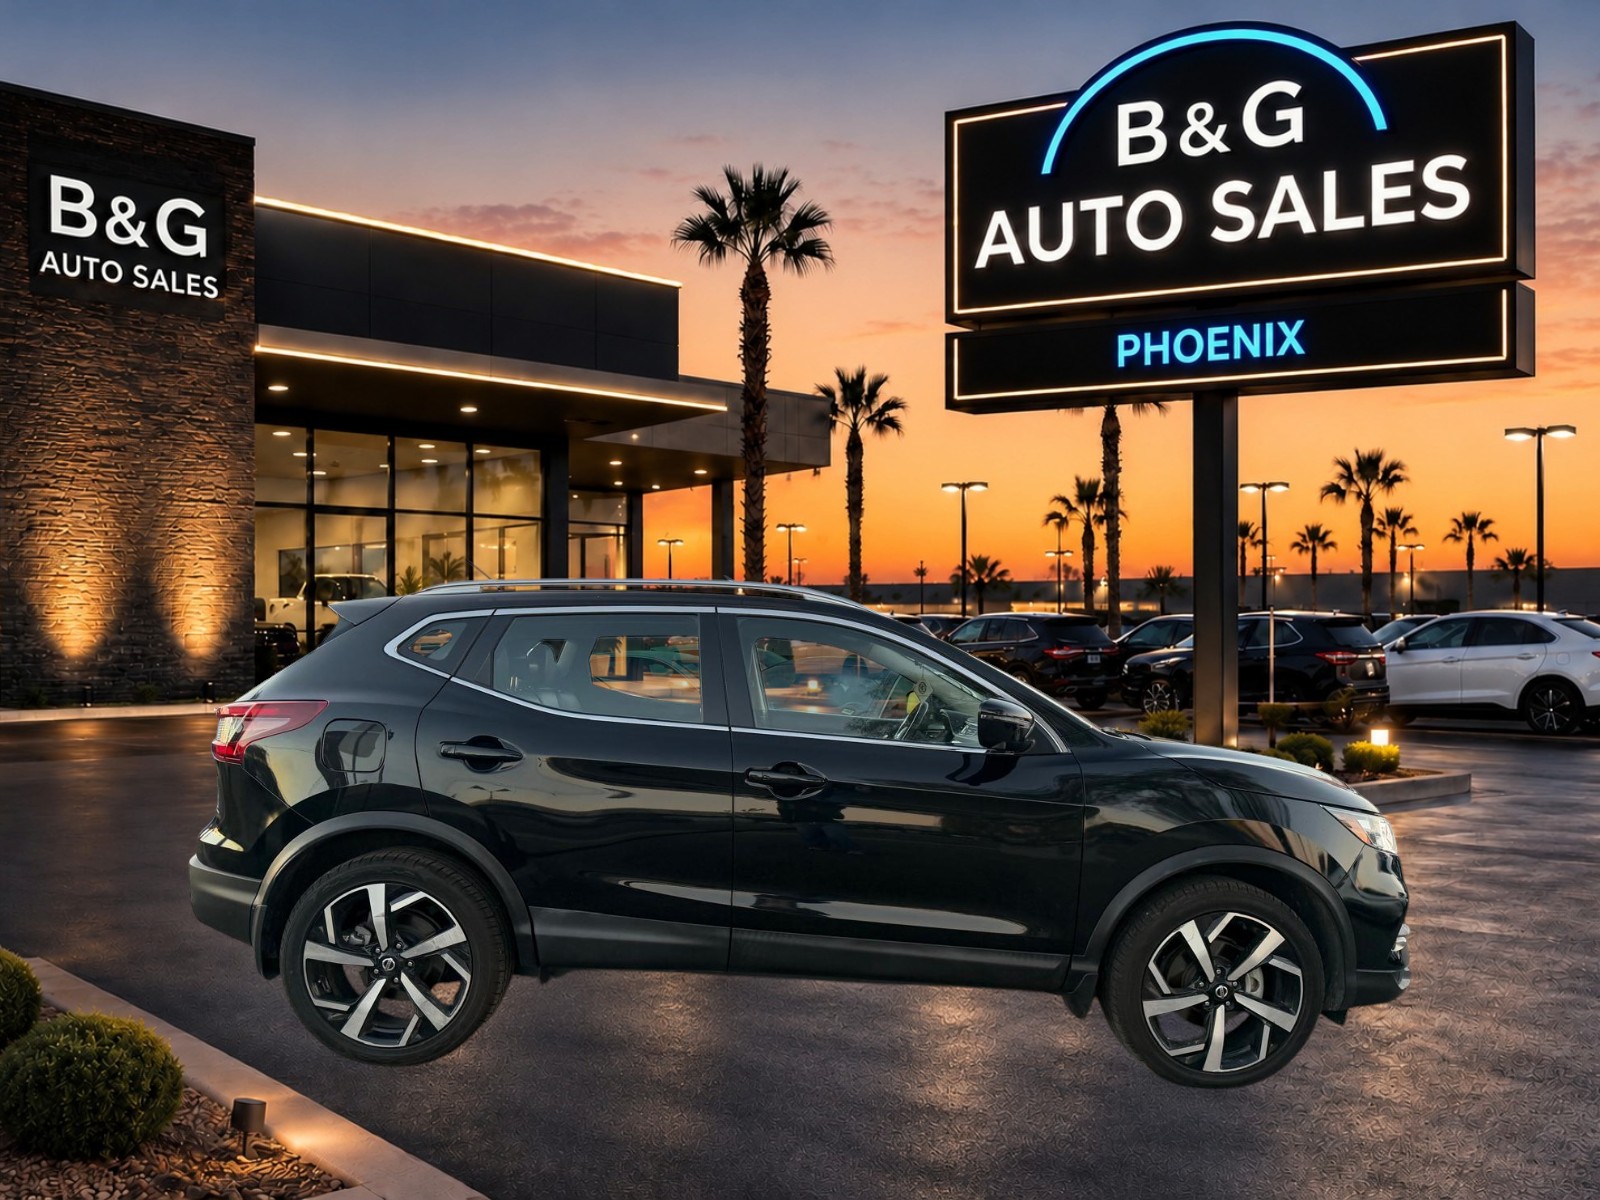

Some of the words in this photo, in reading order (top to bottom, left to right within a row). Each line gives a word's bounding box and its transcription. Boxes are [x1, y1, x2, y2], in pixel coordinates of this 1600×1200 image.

[974, 189, 1183, 269] AUTO
[1210, 154, 1471, 243] SALES
[39, 250, 123, 284] AUTO
[132, 264, 219, 299] SALES
[1117, 319, 1306, 368] PHOENIX
